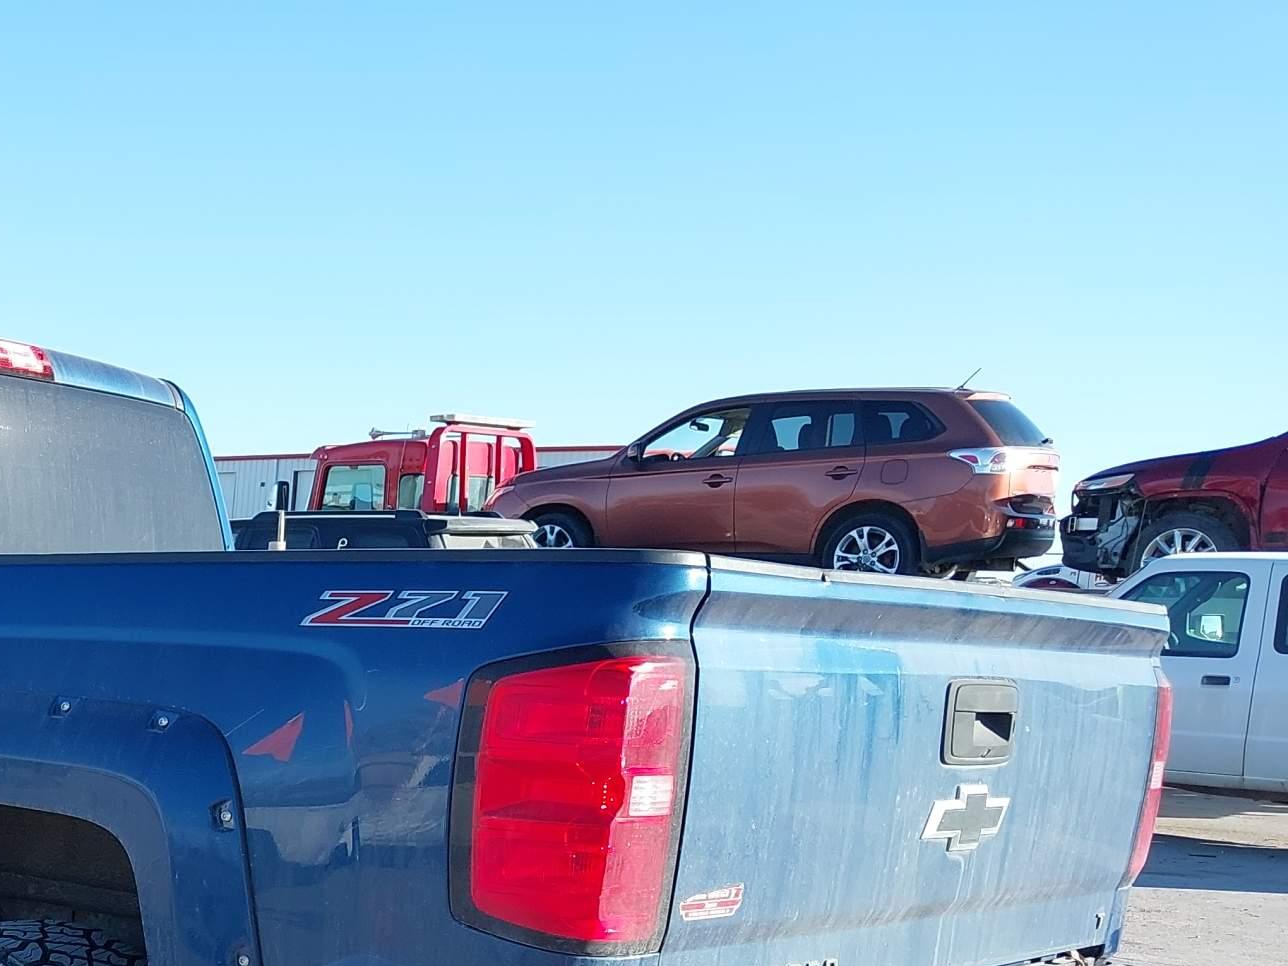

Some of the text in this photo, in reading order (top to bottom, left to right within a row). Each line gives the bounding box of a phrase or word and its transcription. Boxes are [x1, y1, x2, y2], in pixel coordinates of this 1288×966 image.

[298, 589, 511, 629] Z71
[410, 618, 484, 628] OFF ROAD
